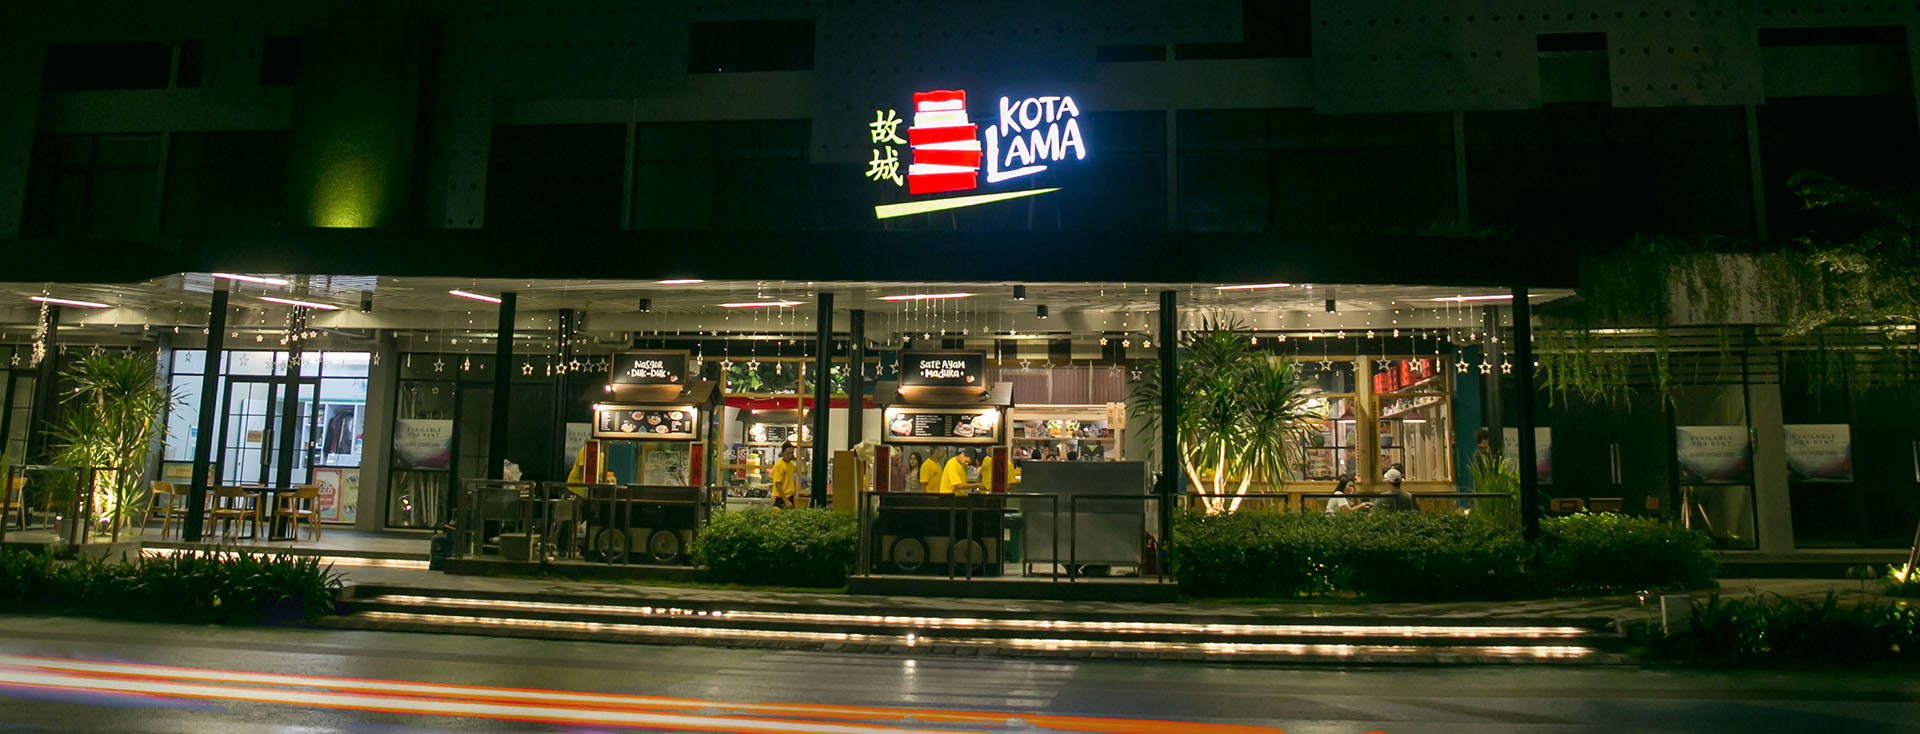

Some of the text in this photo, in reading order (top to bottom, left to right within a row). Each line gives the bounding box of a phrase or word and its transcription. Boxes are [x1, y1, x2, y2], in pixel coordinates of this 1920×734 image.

[865, 108, 907, 187] 故城
[999, 95, 1080, 137] KOTA
[985, 117, 1086, 183] LAMA
